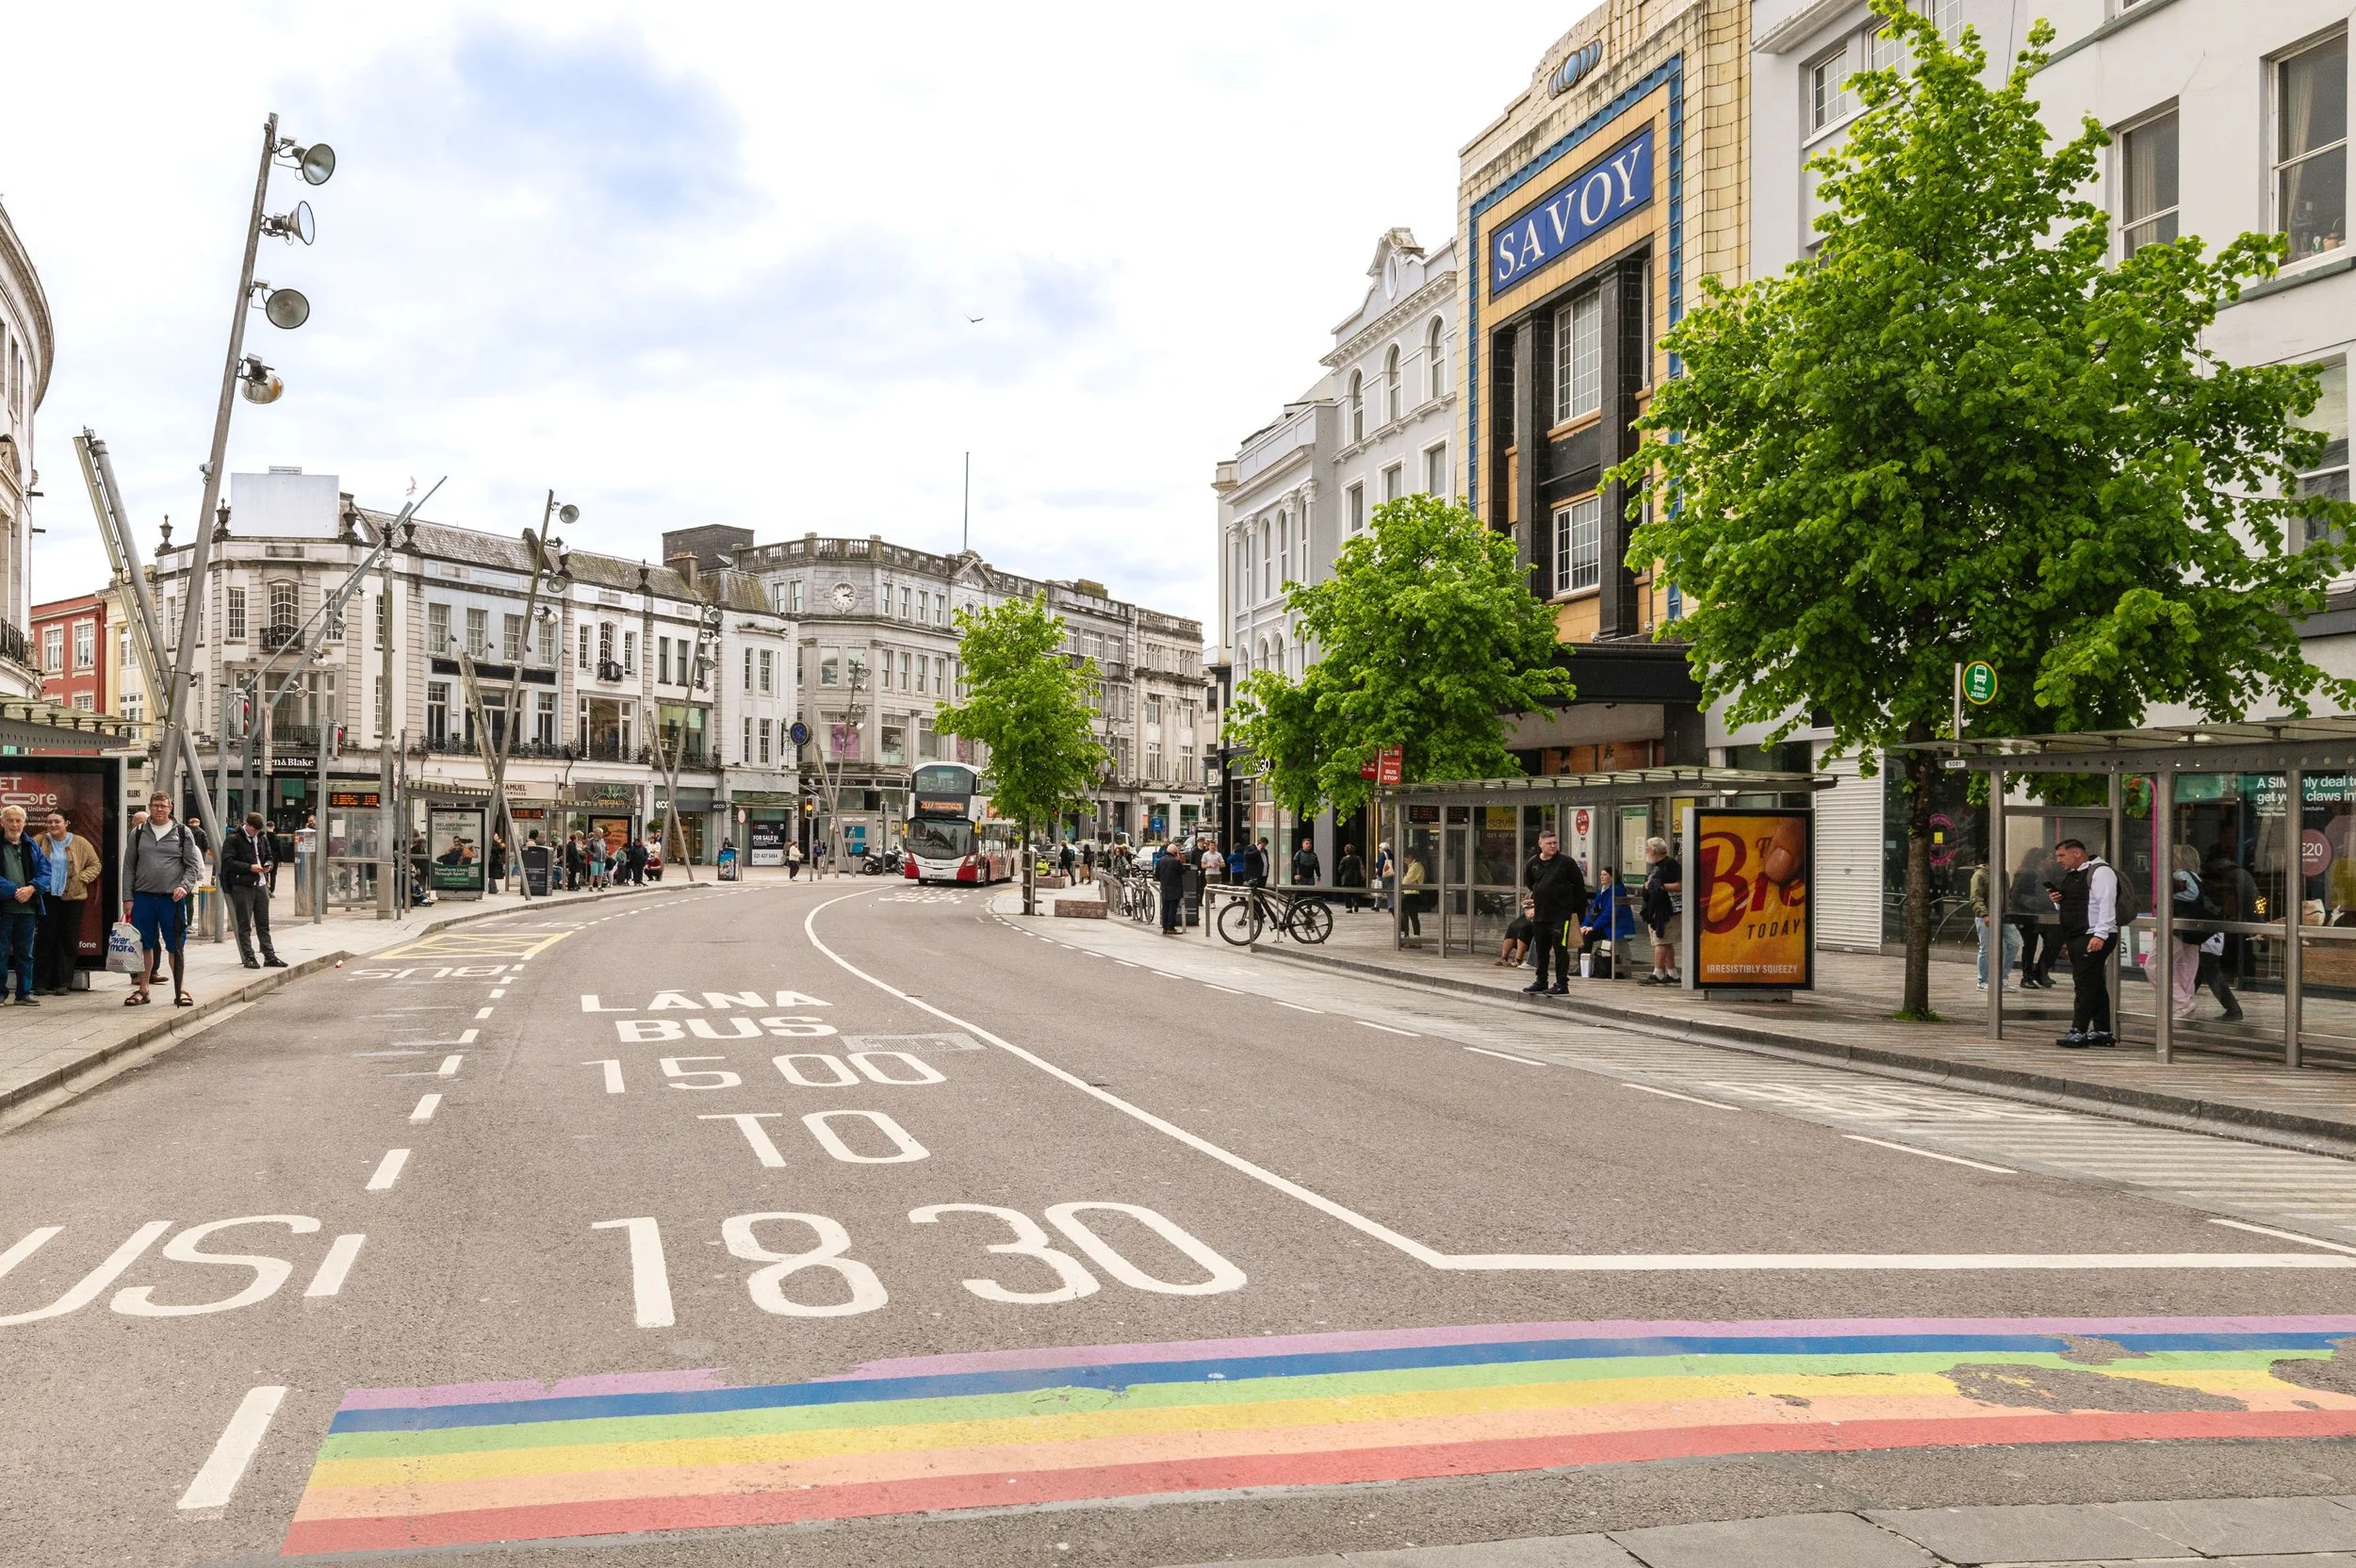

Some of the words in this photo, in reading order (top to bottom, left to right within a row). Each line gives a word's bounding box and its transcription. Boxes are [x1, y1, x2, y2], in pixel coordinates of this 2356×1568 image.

[1498, 143, 1644, 283] SAVOY
[1973, 684, 1986, 693] Stop
[2256, 777, 2266, 788] A
[2302, 776, 2318, 790] nly
[2320, 776, 2346, 788] deal
[656, 800, 669, 808] ecc
[2257, 792, 2276, 805] get
[2306, 790, 2341, 802] claws
[1707, 964, 1760, 973] IRRESISTIBLY
[1762, 964, 1798, 973] SQUEEZY
[581, 988, 834, 1012] LÁNA
[615, 1016, 839, 1042] BUS
[696, 1109, 931, 1168] TO
